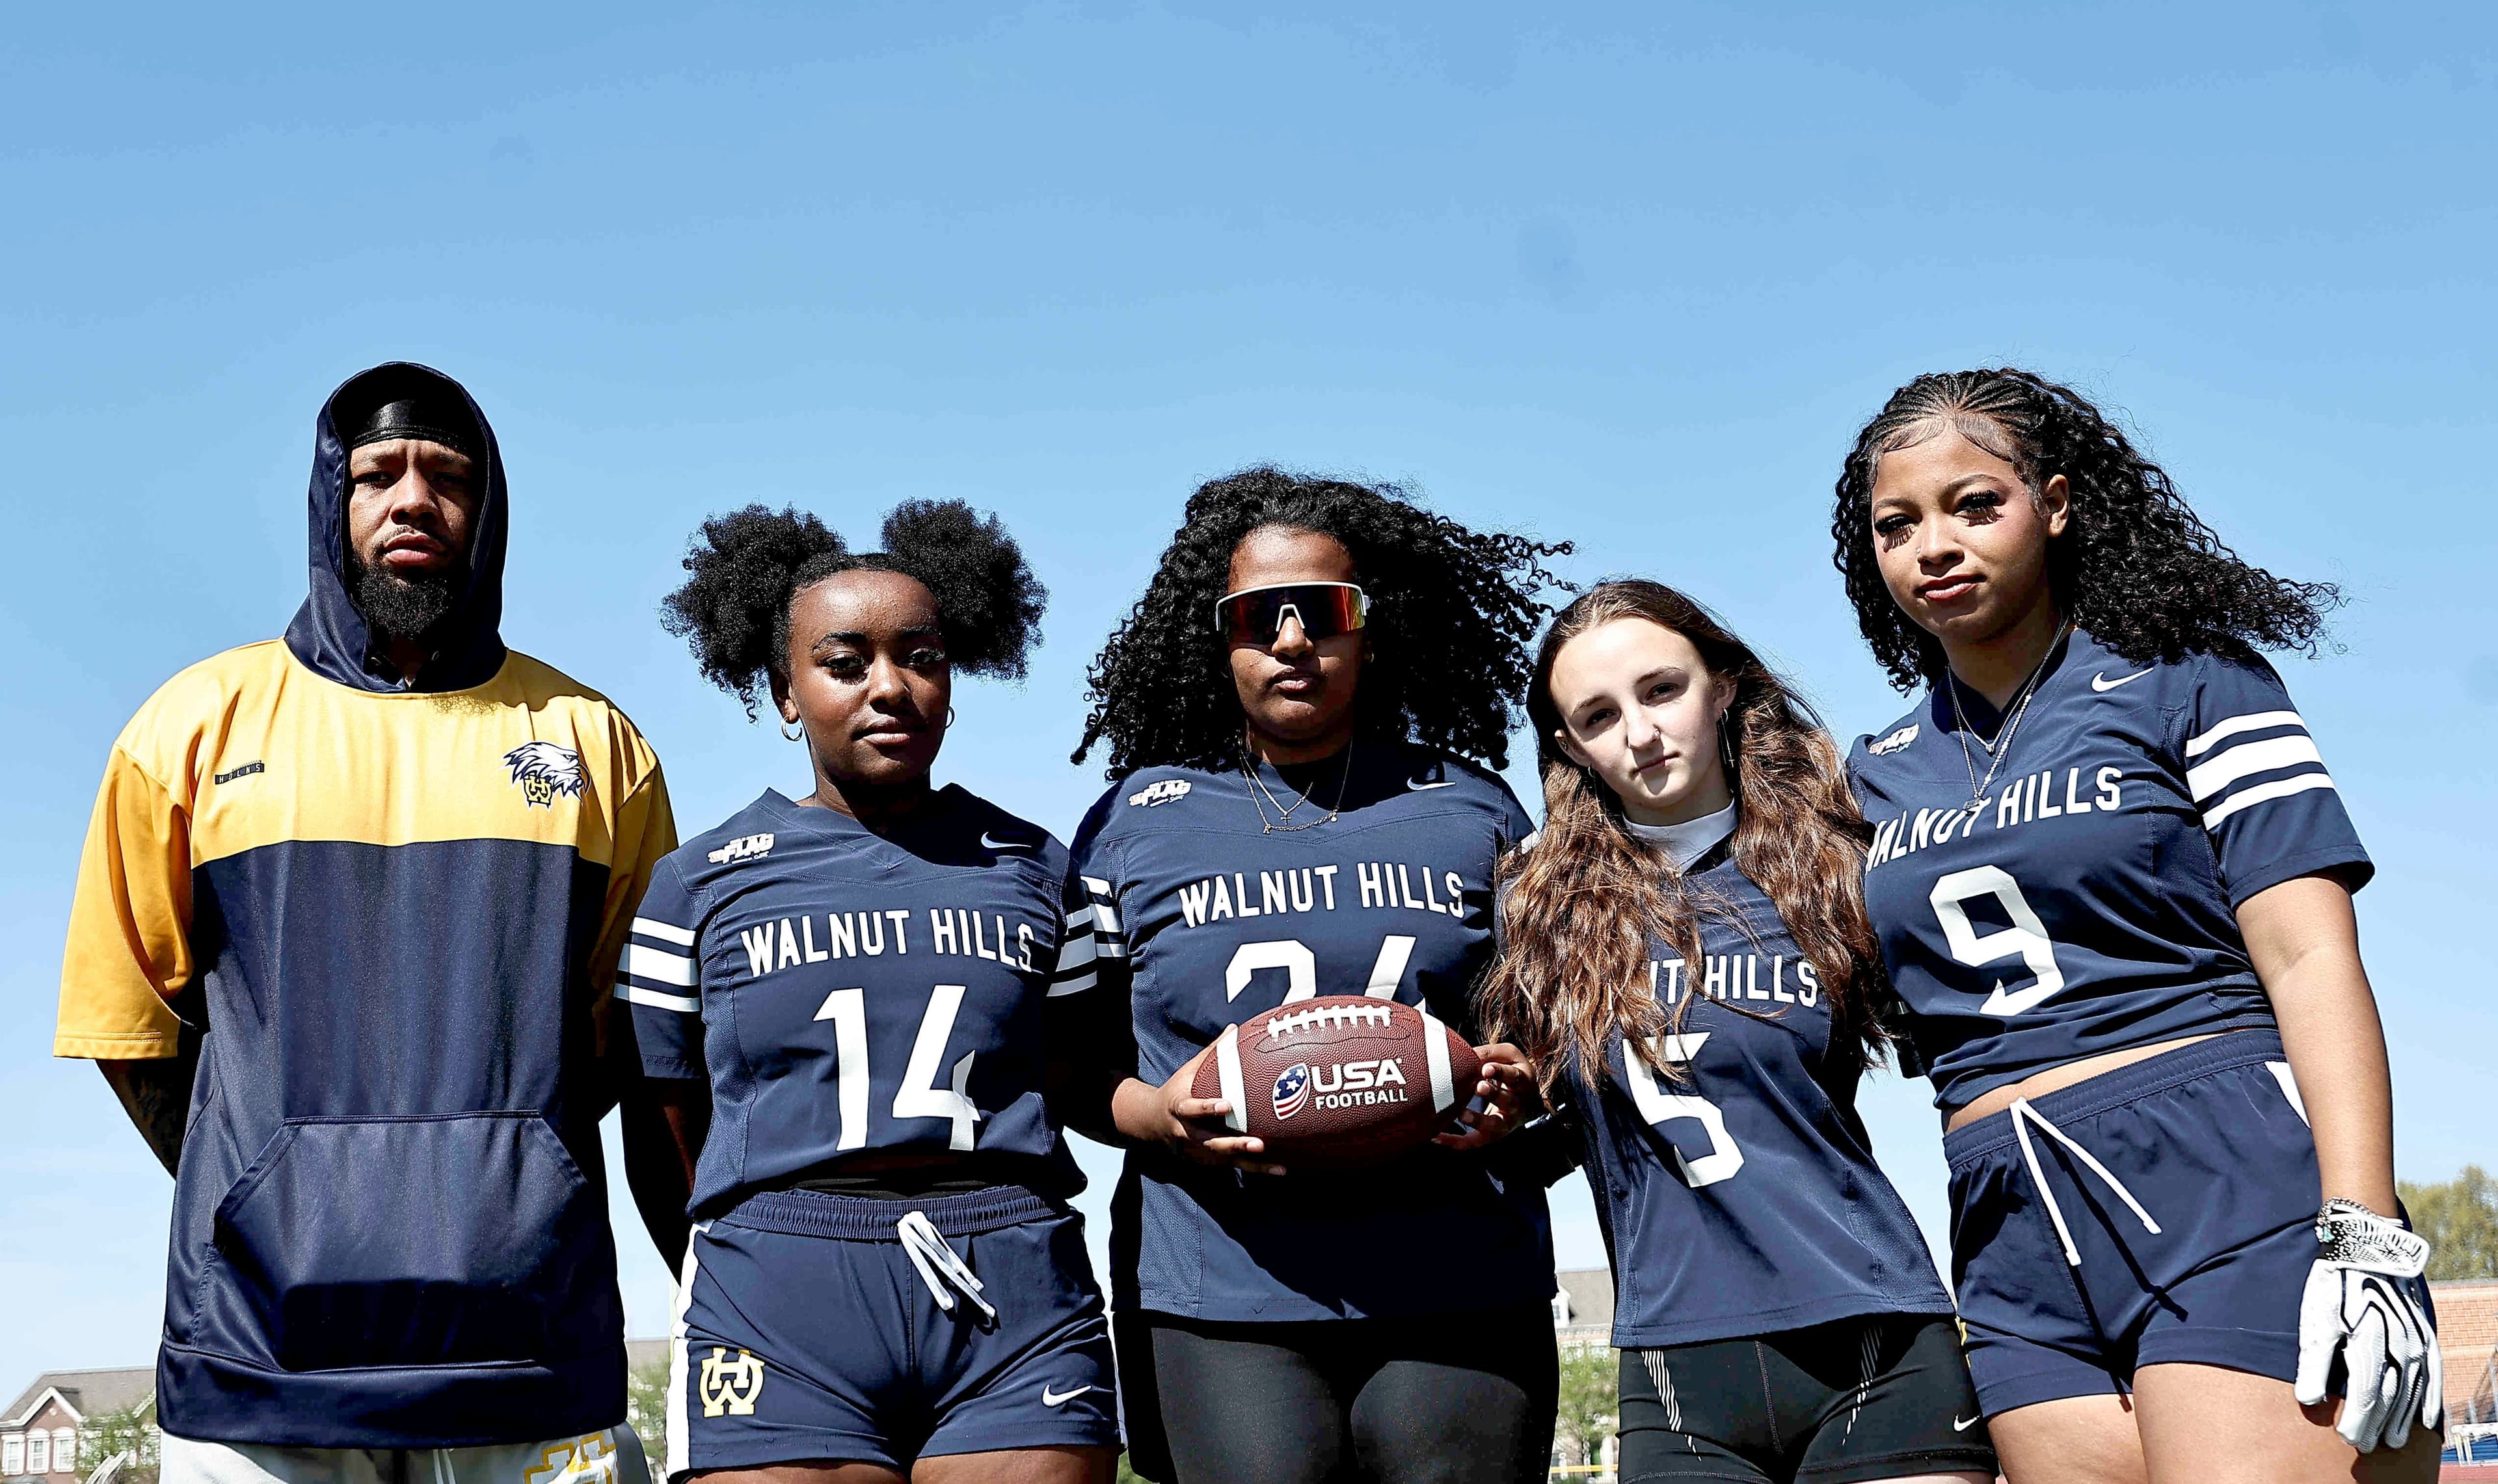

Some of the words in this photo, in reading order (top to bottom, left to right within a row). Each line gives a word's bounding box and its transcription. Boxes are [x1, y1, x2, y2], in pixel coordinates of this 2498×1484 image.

[1996, 767, 2123, 830] HILLS
[1178, 865, 1338, 929] WALNUT
[1357, 862, 1464, 918] HILLS
[740, 910, 909, 977] WALNUT
[930, 908, 1042, 974] HILLS
[1929, 864, 2065, 1016] 9
[1704, 954, 1819, 1008] HILLS
[813, 984, 981, 1151] 14
[1311, 1059, 1406, 1093] USA
[1315, 1089, 1408, 1110] FOOTBALL
[1622, 1031, 1745, 1188] 5
